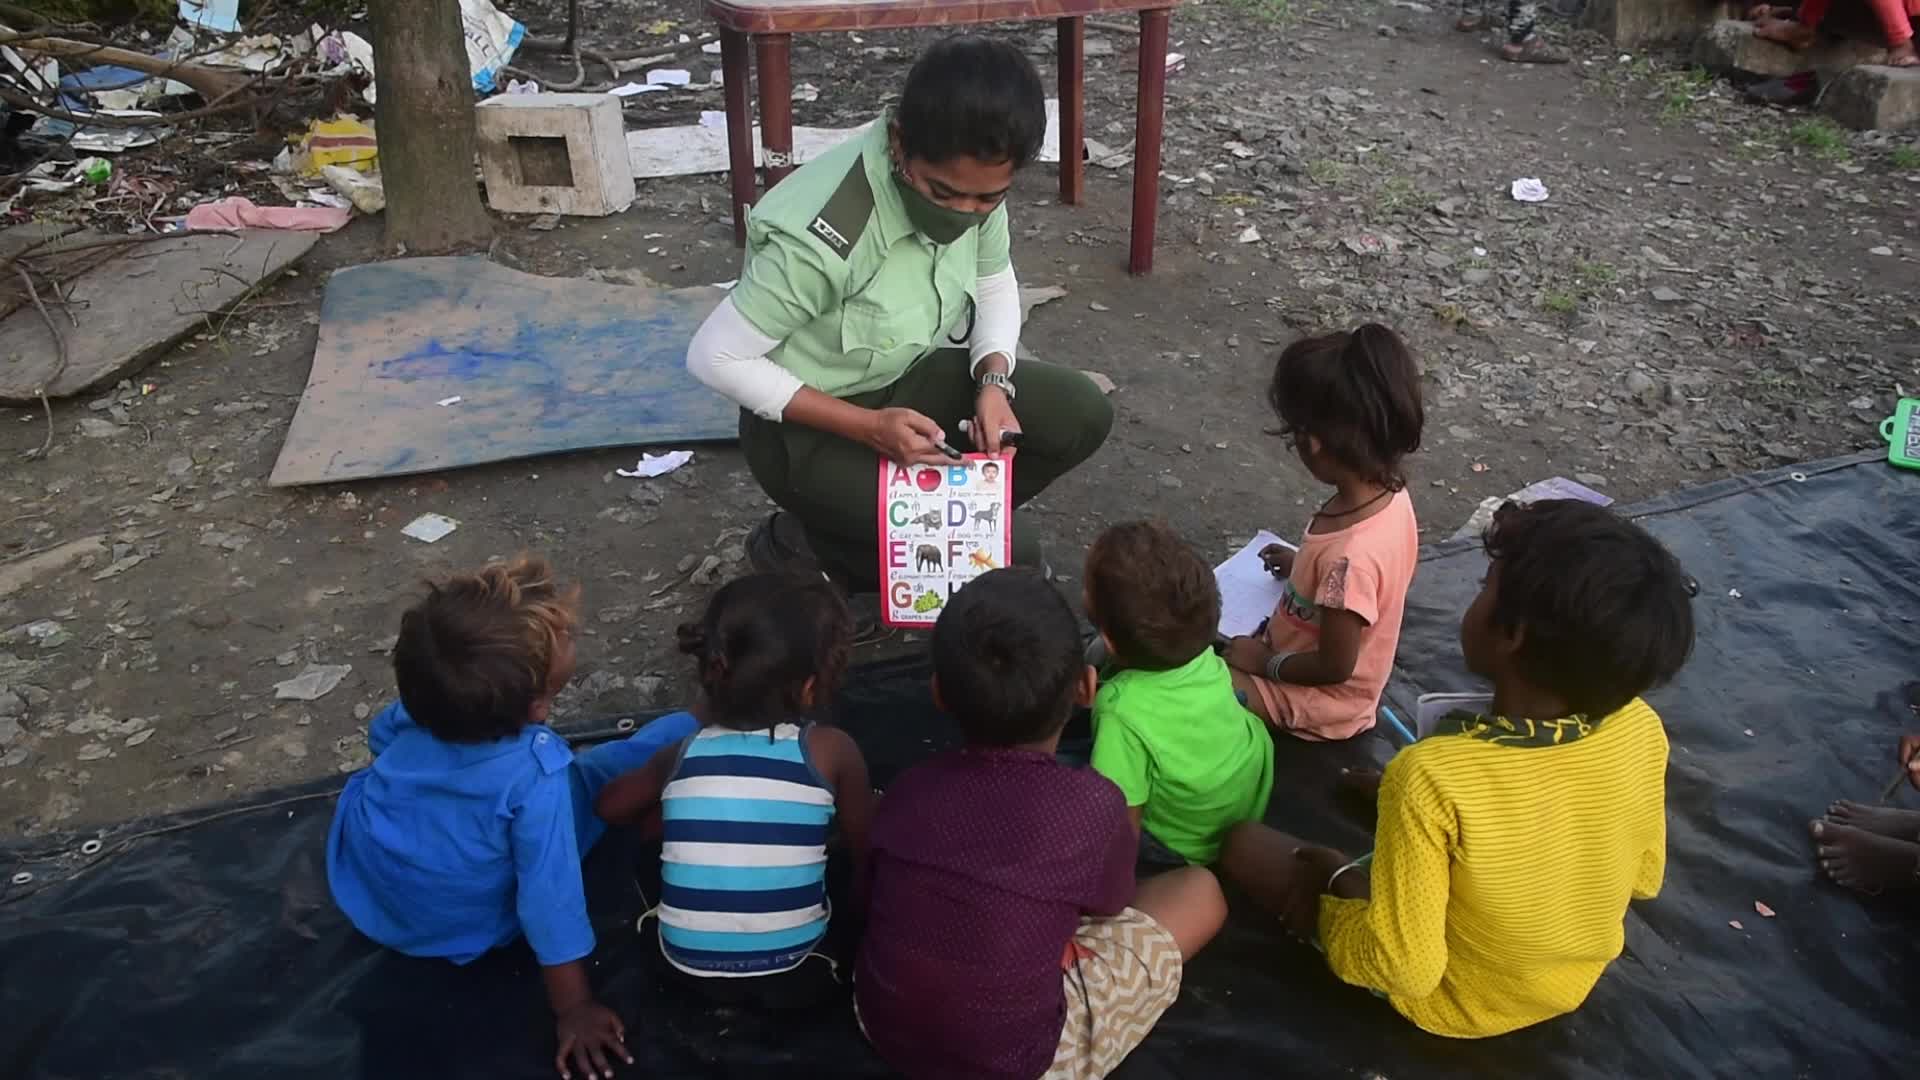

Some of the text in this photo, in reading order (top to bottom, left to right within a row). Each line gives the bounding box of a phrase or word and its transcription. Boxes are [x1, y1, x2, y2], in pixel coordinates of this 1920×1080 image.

[889, 464, 912, 487] A
[947, 465, 968, 487] B
[889, 500, 909, 527] C
[947, 500, 967, 527] D
[889, 541, 908, 568] E
[947, 540, 964, 568] F
[891, 581, 912, 609] G
